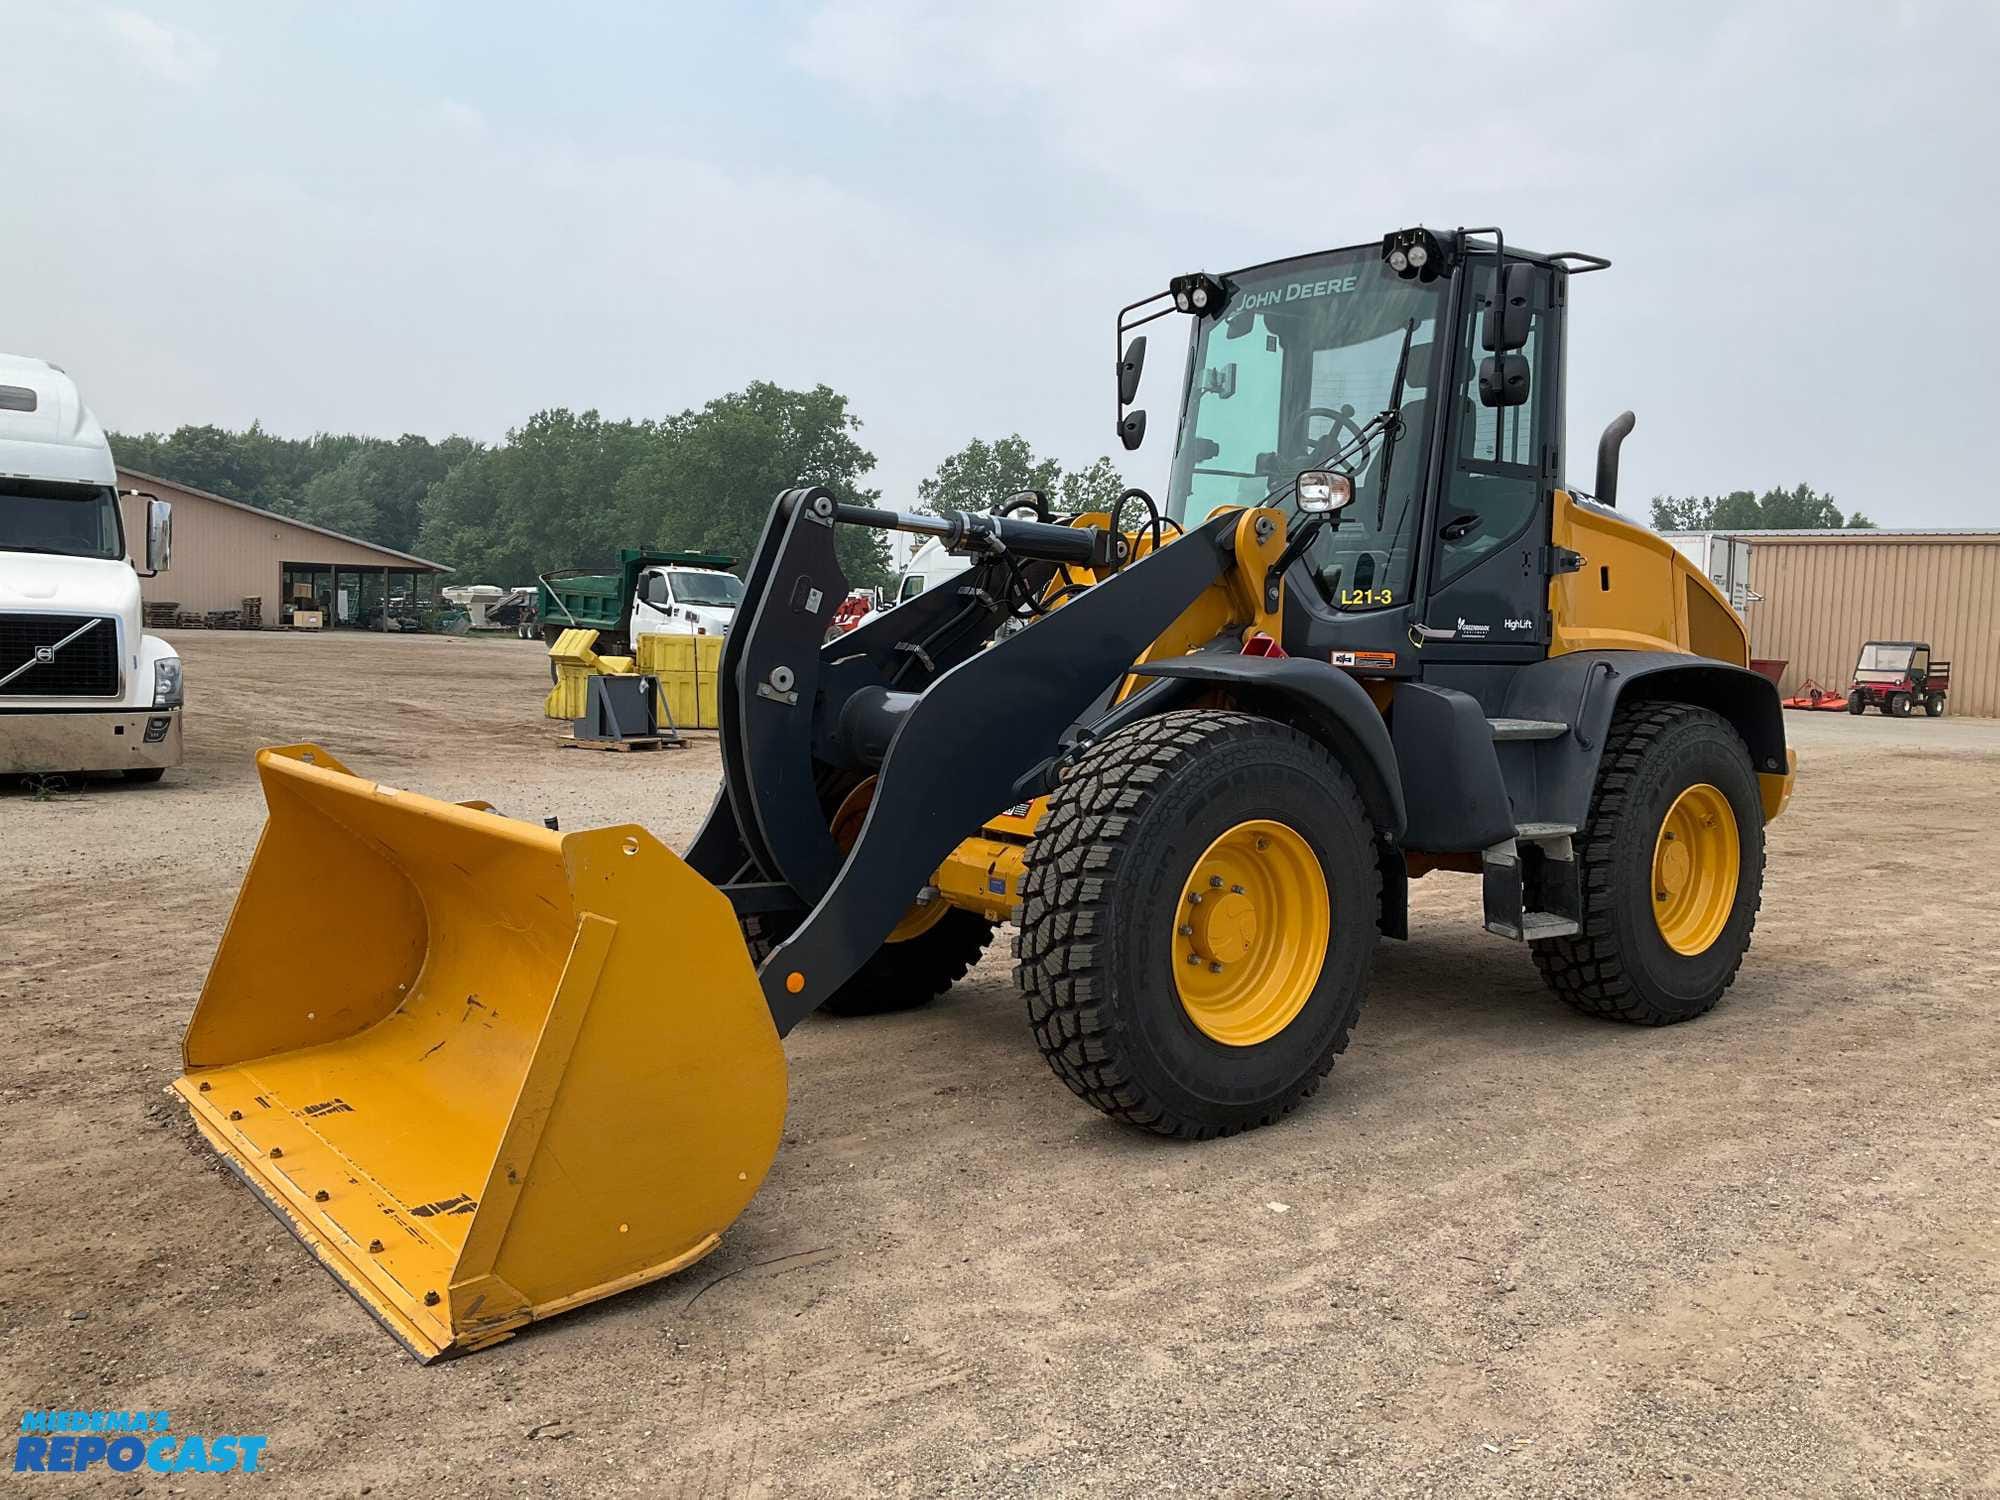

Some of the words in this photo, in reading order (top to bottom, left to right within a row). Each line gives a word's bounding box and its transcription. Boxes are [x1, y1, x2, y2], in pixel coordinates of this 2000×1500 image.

[1237, 290, 1281, 311] JOHN
[1285, 276, 1357, 301] DEERE
[1341, 589, 1393, 605] L21-3
